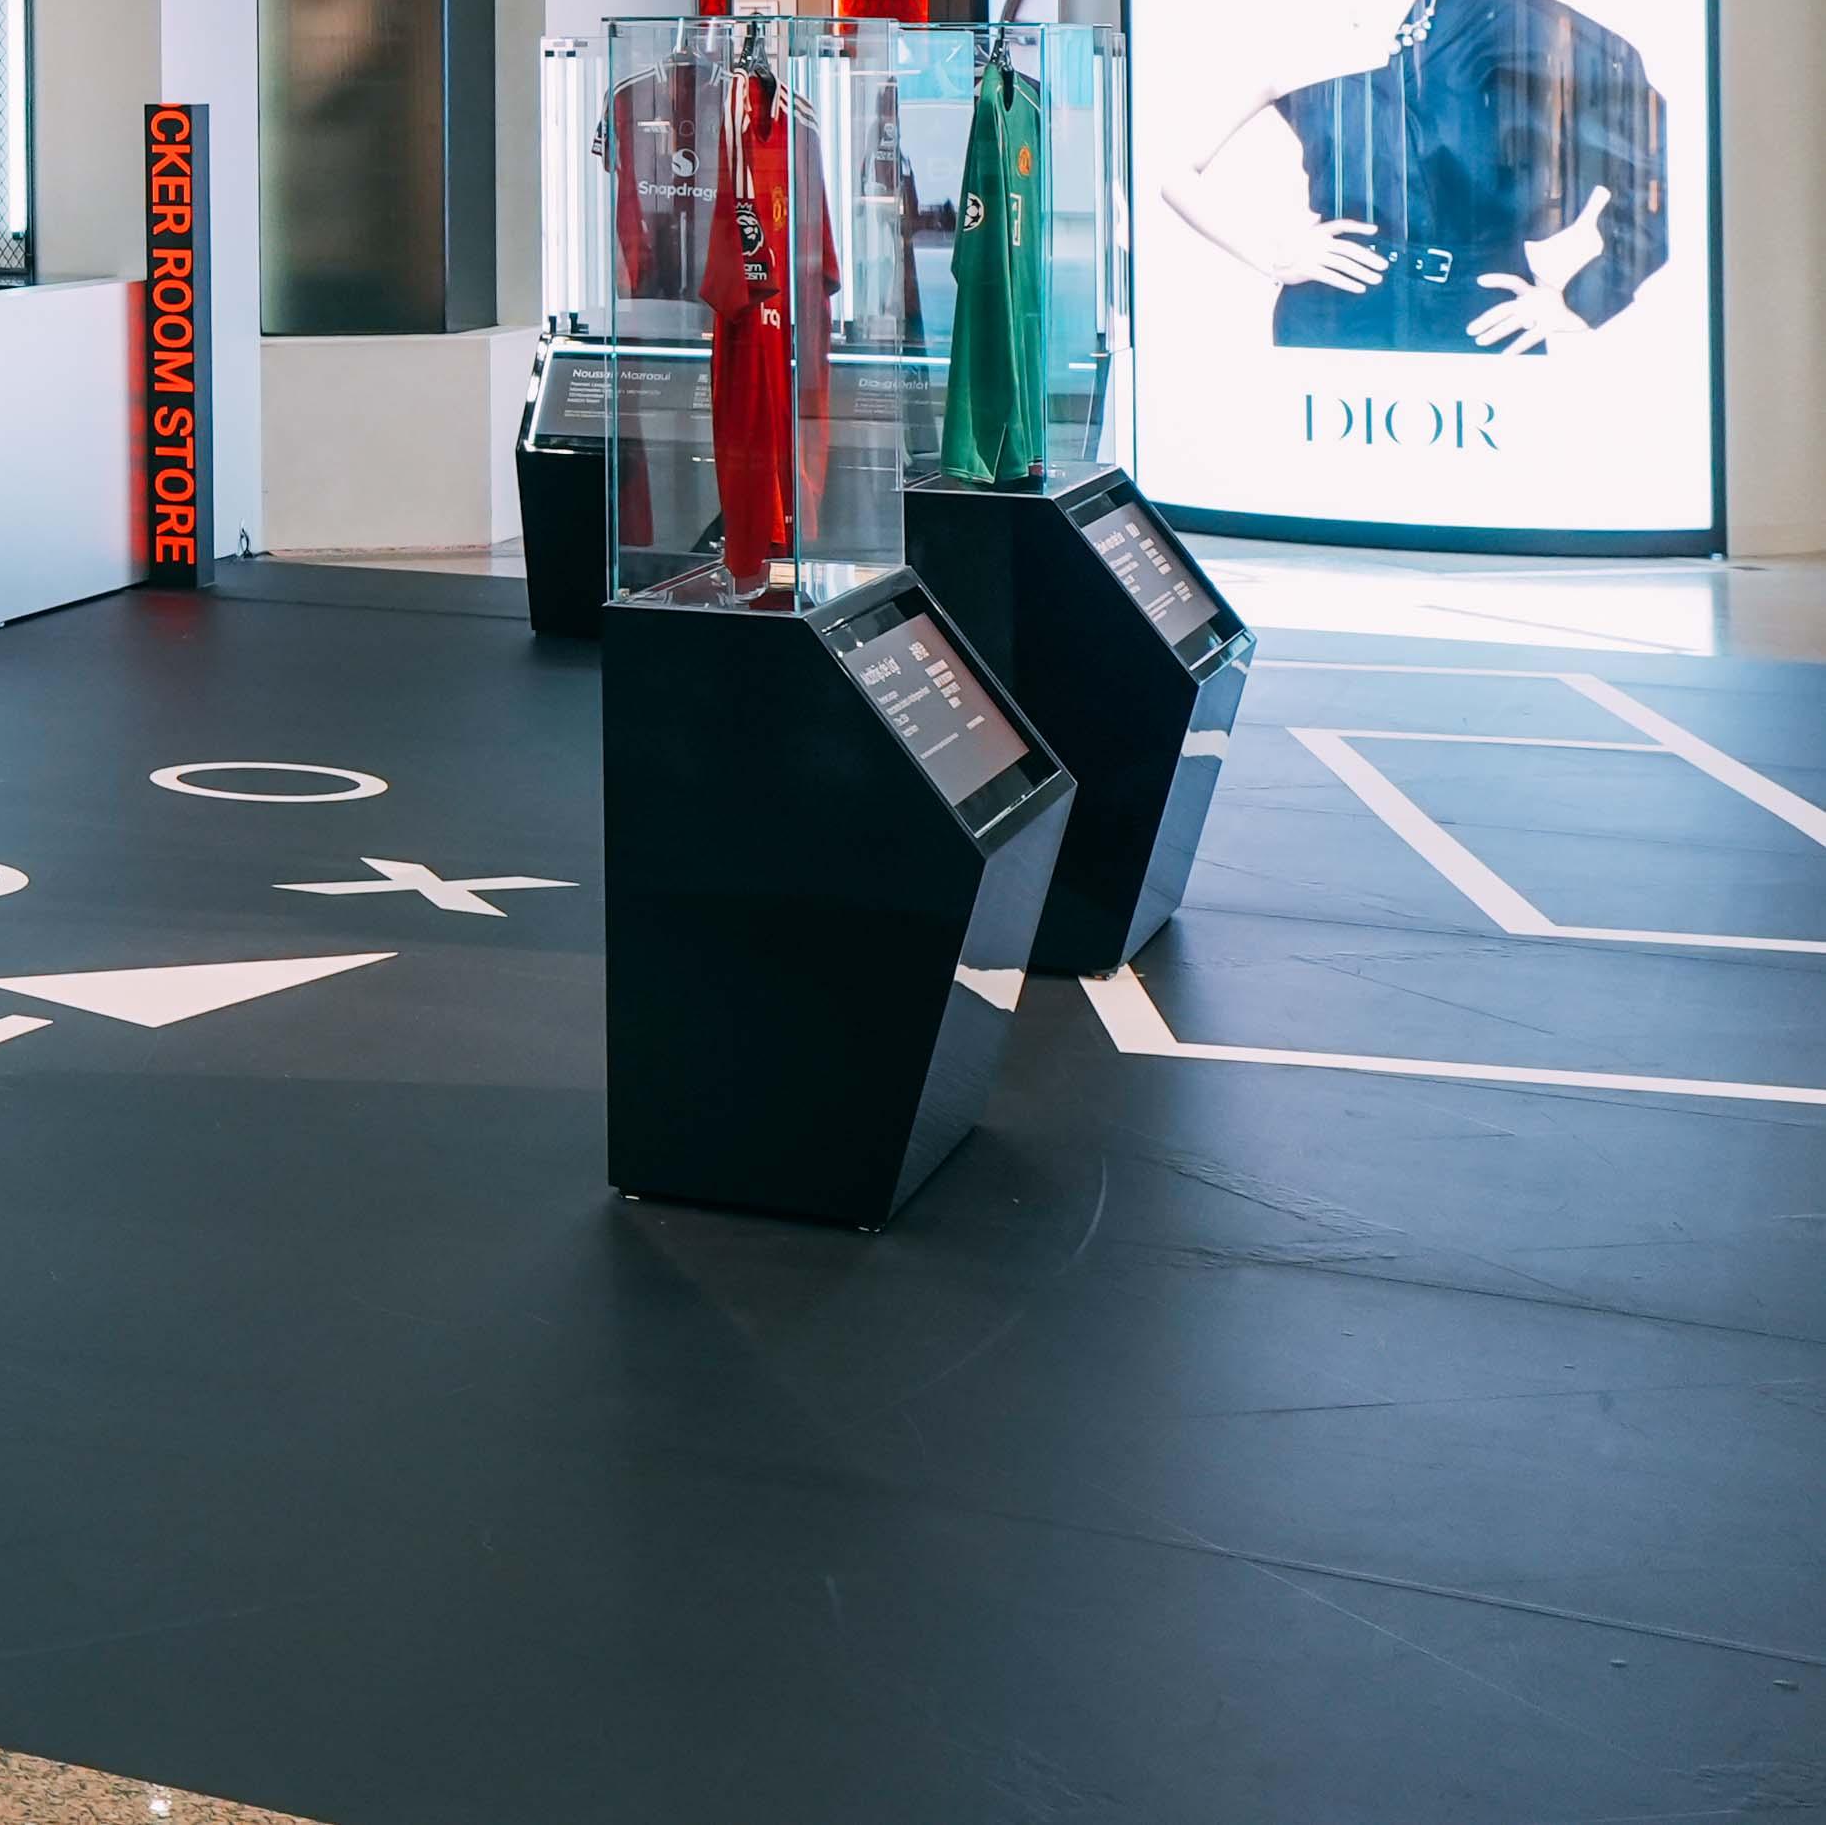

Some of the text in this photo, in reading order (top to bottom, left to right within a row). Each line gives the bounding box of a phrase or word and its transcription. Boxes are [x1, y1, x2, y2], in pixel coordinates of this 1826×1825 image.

[637, 179, 718, 202] Snapdrag
[152, 247, 195, 393] ROOM
[1302, 391, 1503, 453] DIOR
[153, 404, 197, 567] STORE
